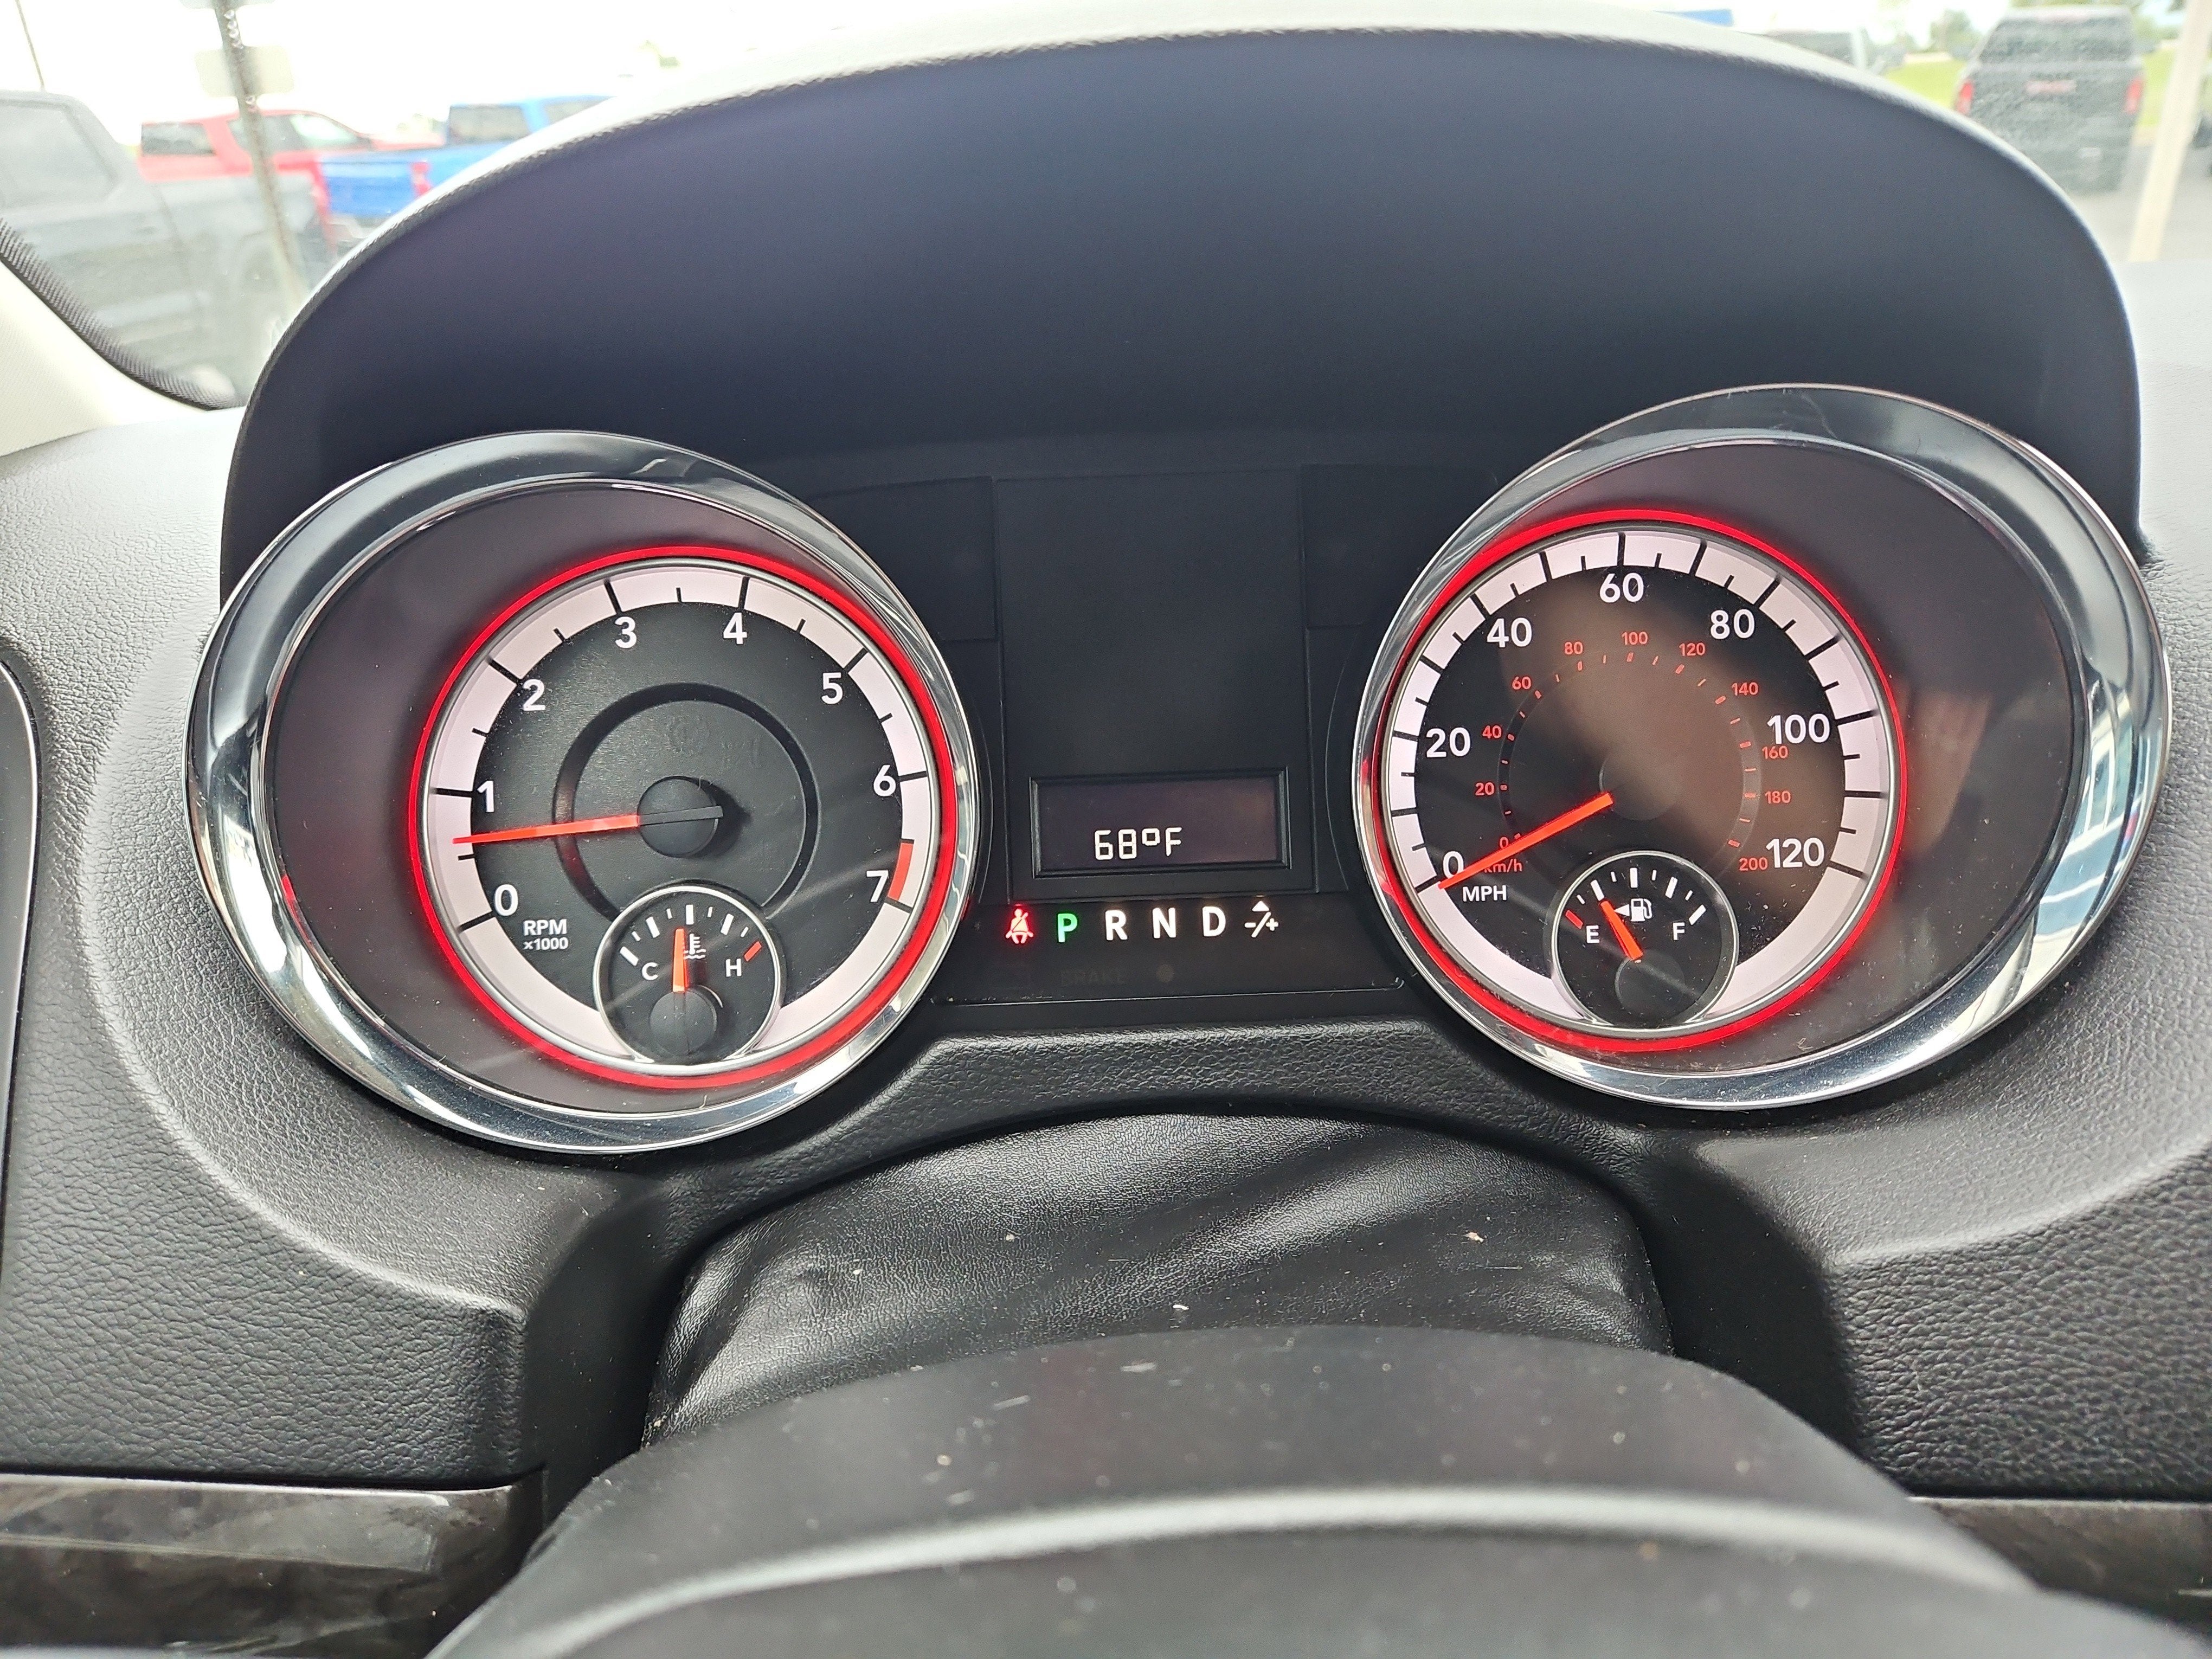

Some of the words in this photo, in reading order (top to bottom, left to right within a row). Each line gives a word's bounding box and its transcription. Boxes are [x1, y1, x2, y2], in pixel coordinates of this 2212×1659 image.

[1599, 573, 1644, 603] 60
[614, 616, 637, 648] 3
[723, 613, 748, 645] 4
[1487, 618, 1532, 647] 40
[1711, 609, 1755, 639] 80
[1564, 641, 1583, 654] 80
[1622, 632, 1648, 645] 100
[1679, 642, 1706, 657] 120
[821, 672, 843, 704] 5
[1512, 676, 1532, 690] 60
[1731, 682, 1759, 696] 140
[523, 679, 546, 711] 2
[1482, 725, 1502, 739] 40
[1767, 713, 1830, 744] 100
[1426, 727, 1471, 758] 20
[1762, 745, 1789, 759] 160
[873, 764, 896, 797] 6
[1475, 782, 1495, 796] 20
[477, 780, 495, 813] 1
[1765, 790, 1791, 804] 180
[1500, 837, 1509, 849] 0
[1766, 838, 1824, 869] 120
[1443, 851, 1464, 879] 0
[1739, 857, 1768, 871] 200
[866, 870, 889, 902] 7
[1463, 885, 1507, 902] MPH
[494, 884, 519, 916] 0
[523, 918, 568, 936] RPM
[1057, 913, 1078, 943] P
[1105, 910, 1128, 941] R
[1152, 908, 1176, 939] N
[1202, 906, 1226, 937] D
[1586, 925, 1600, 943] E
[1673, 922, 1685, 941] F
[641, 962, 659, 980] C
[725, 959, 742, 977] H
